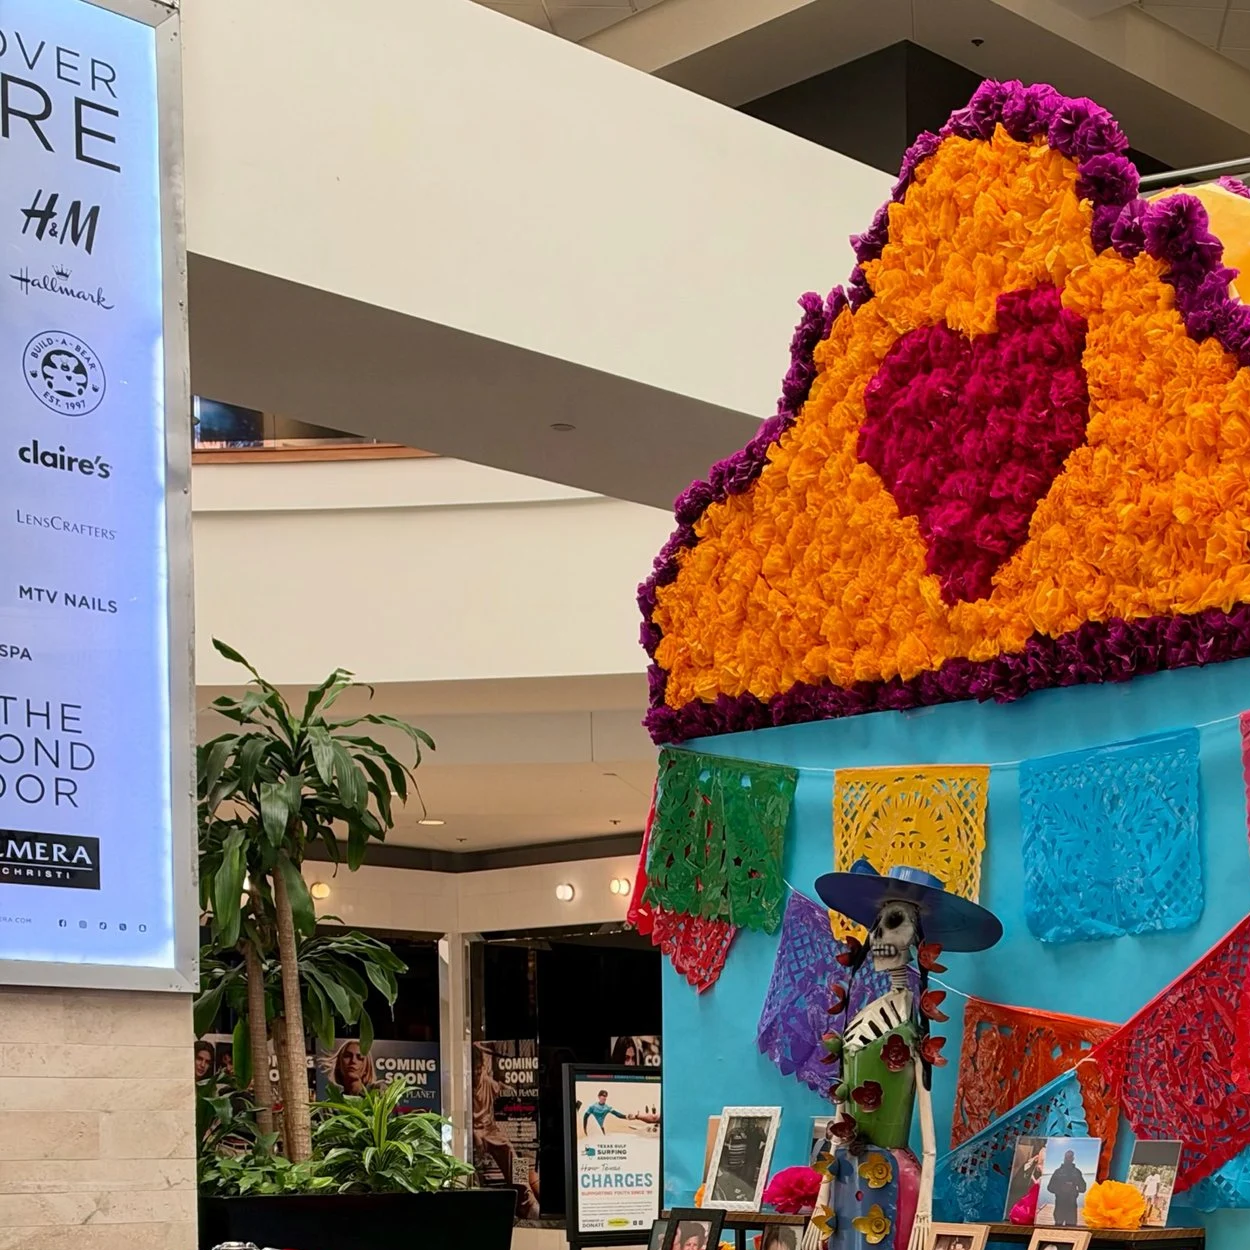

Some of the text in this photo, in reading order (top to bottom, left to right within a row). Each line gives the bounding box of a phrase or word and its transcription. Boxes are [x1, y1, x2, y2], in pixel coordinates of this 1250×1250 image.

[1, 72, 121, 173] RE
[20, 189, 100, 255] H&M
[9, 266, 115, 310] Hallmark
[43, 391, 86, 411] EST. 1997
[18, 439, 111, 479] claire's
[19, 585, 118, 613] MTV NAILS
[0, 644, 32, 661] SPA
[0, 695, 82, 734] THE
[0, 774, 79, 808] OR
[0, 839, 92, 864] MERA
[2, 867, 70, 879] CHRISTI
[375, 1057, 436, 1071] COMING
[498, 1057, 538, 1069] COMING
[385, 1072, 427, 1085] SOON
[505, 1071, 533, 1083] SOON
[581, 1173, 653, 1188] CHARGES
